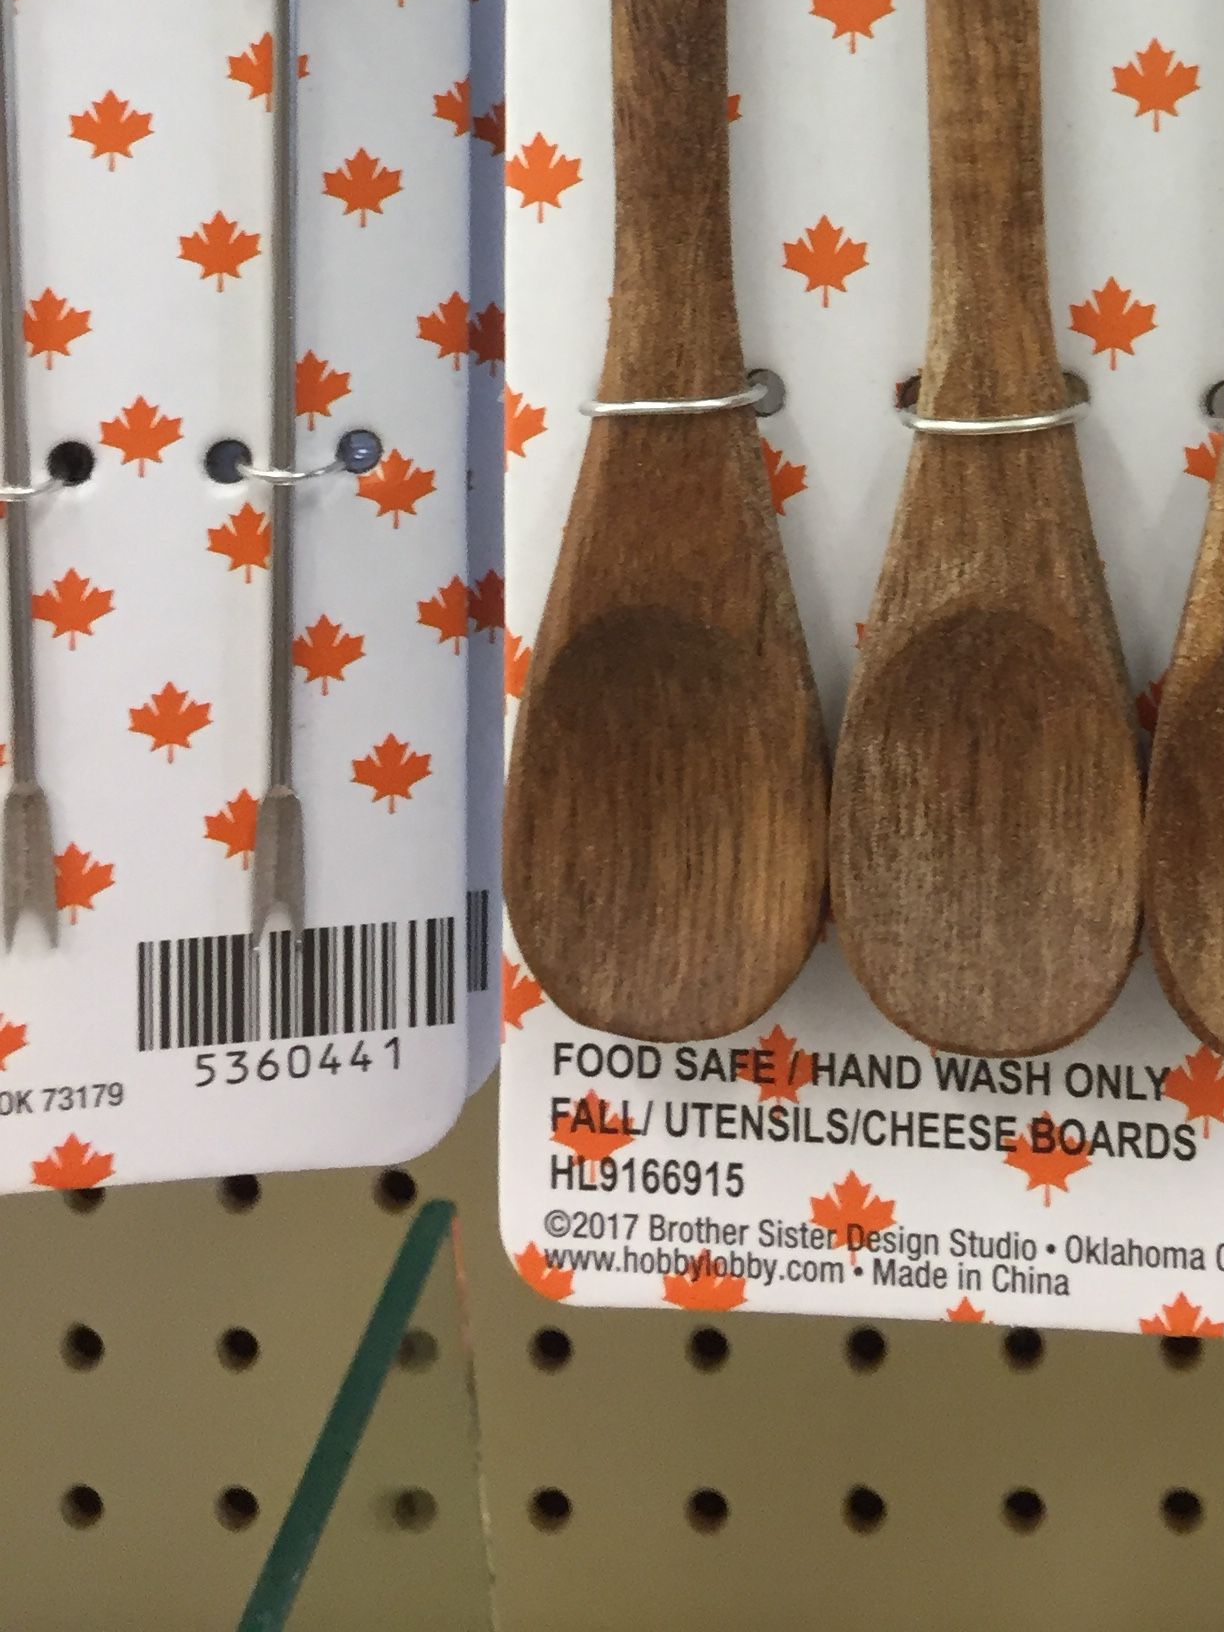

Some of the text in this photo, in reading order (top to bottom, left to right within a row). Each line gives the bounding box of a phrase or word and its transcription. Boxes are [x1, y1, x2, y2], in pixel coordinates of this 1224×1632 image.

[195, 1036, 402, 1088] 5360441
[553, 1043, 662, 1080] FOOD
[674, 1048, 776, 1085] SAFE
[811, 1052, 922, 1091] HAND
[934, 1056, 1051, 1097] WASH
[1065, 1062, 1170, 1102] ONLY
[42, 1081, 125, 1112] 73179
[551, 1096, 1198, 1162] FALL/ UTENSILS/CHEESE BOARDS
[551, 1155, 745, 1198] HL9166915
[544, 1209, 639, 1241] ©2017
[649, 1214, 749, 1246] Brother
[759, 1219, 837, 1251] Sister
[847, 1223, 940, 1262] Design
[950, 1227, 1038, 1262] Studio
[1065, 1235, 1206, 1272] Oklahoma
[544, 1247, 1071, 1297] www.hobbylobby.com Made in China
